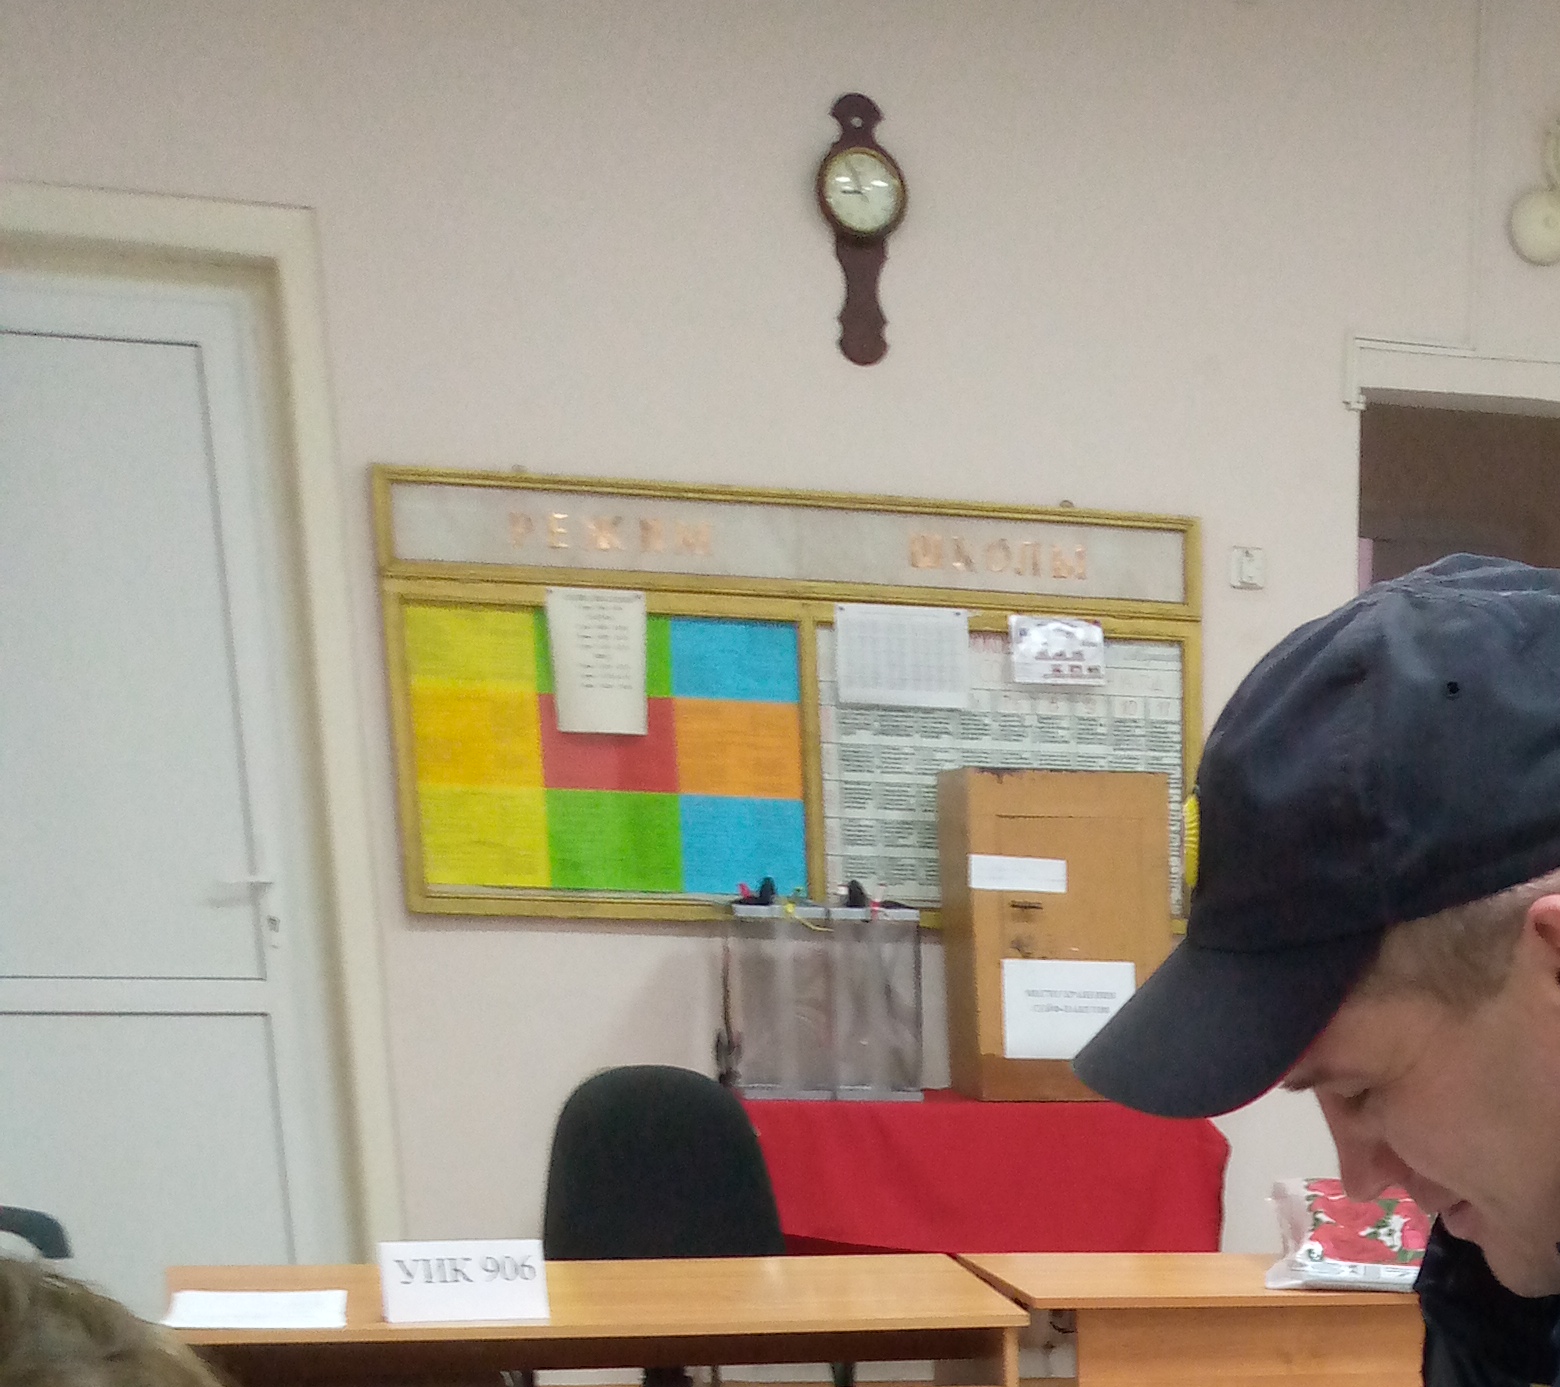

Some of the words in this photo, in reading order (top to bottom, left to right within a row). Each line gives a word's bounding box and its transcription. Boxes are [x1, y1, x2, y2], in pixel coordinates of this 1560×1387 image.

[909, 532, 1087, 581] ШКОЛЫ
[393, 1257, 473, 1285] УИК
[480, 1254, 537, 1282] 906
